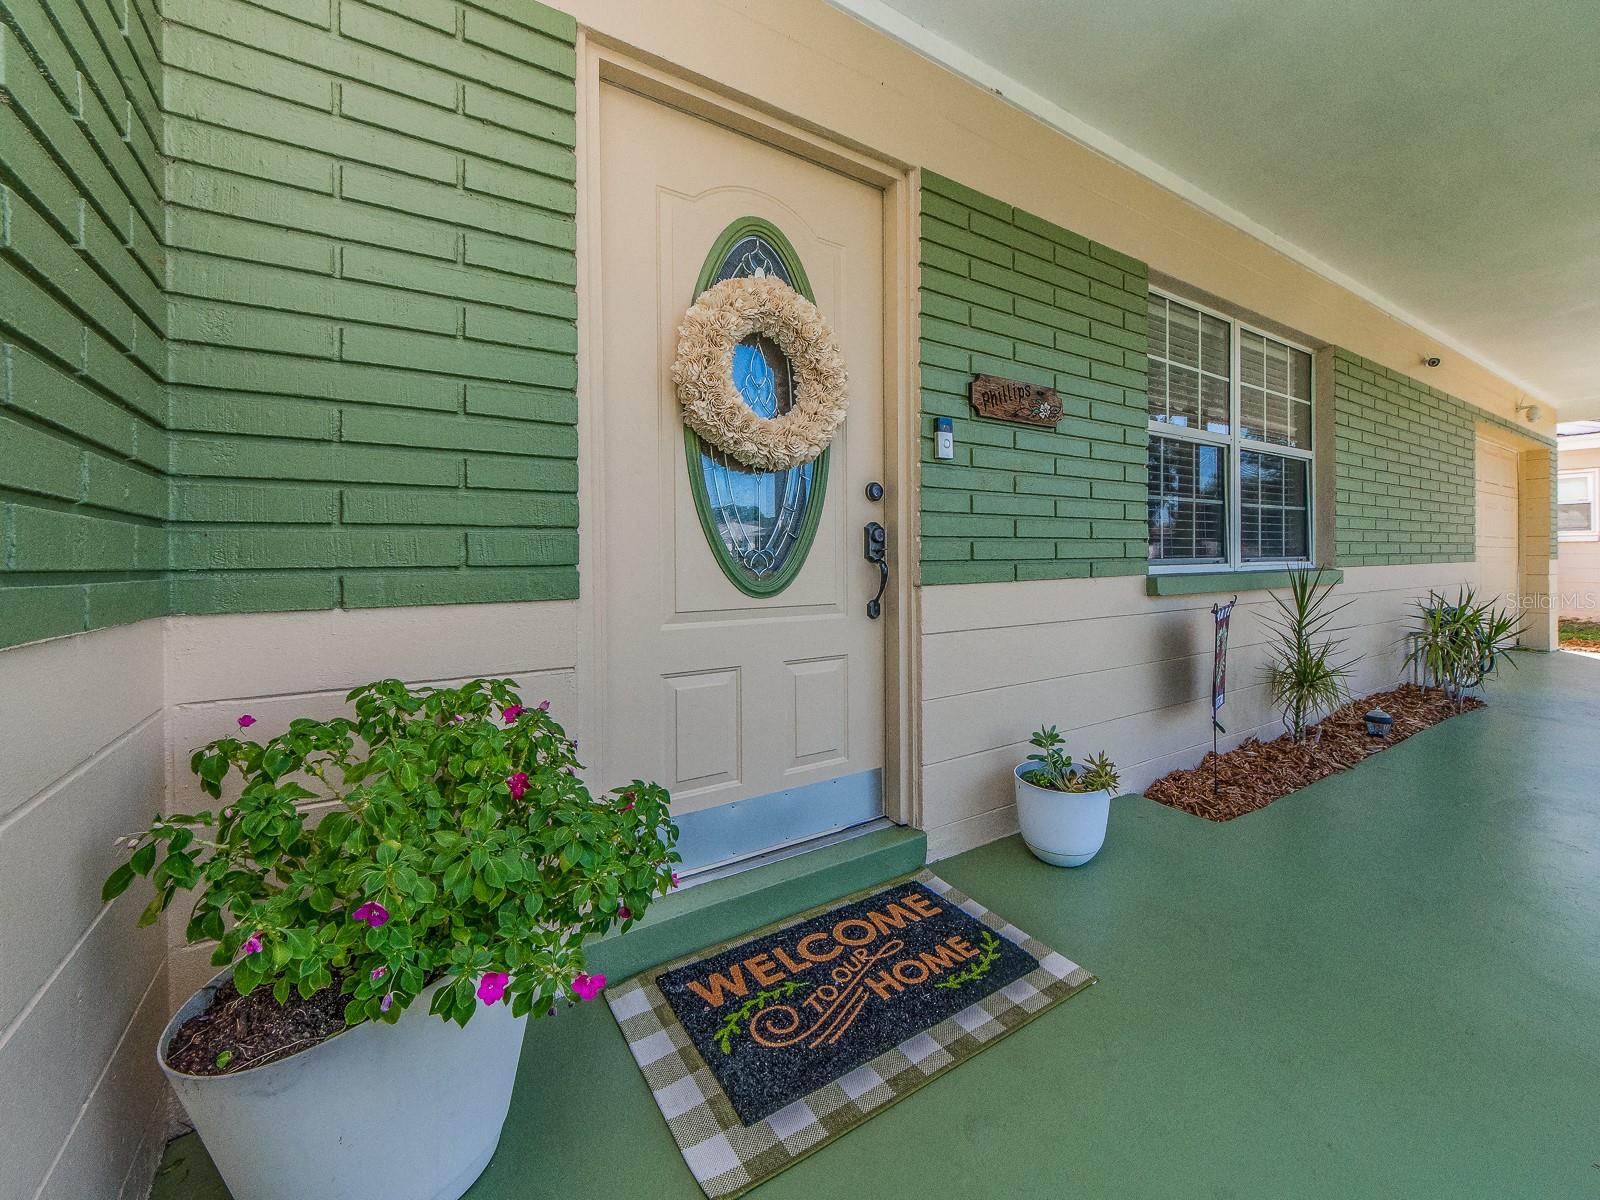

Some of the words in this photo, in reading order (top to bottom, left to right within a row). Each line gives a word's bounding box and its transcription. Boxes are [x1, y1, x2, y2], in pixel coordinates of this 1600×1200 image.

[687, 893, 942, 1007] WELCOME
[803, 984, 839, 1013] TO
[831, 948, 870, 984] OUR
[864, 935, 980, 1000] HOME
